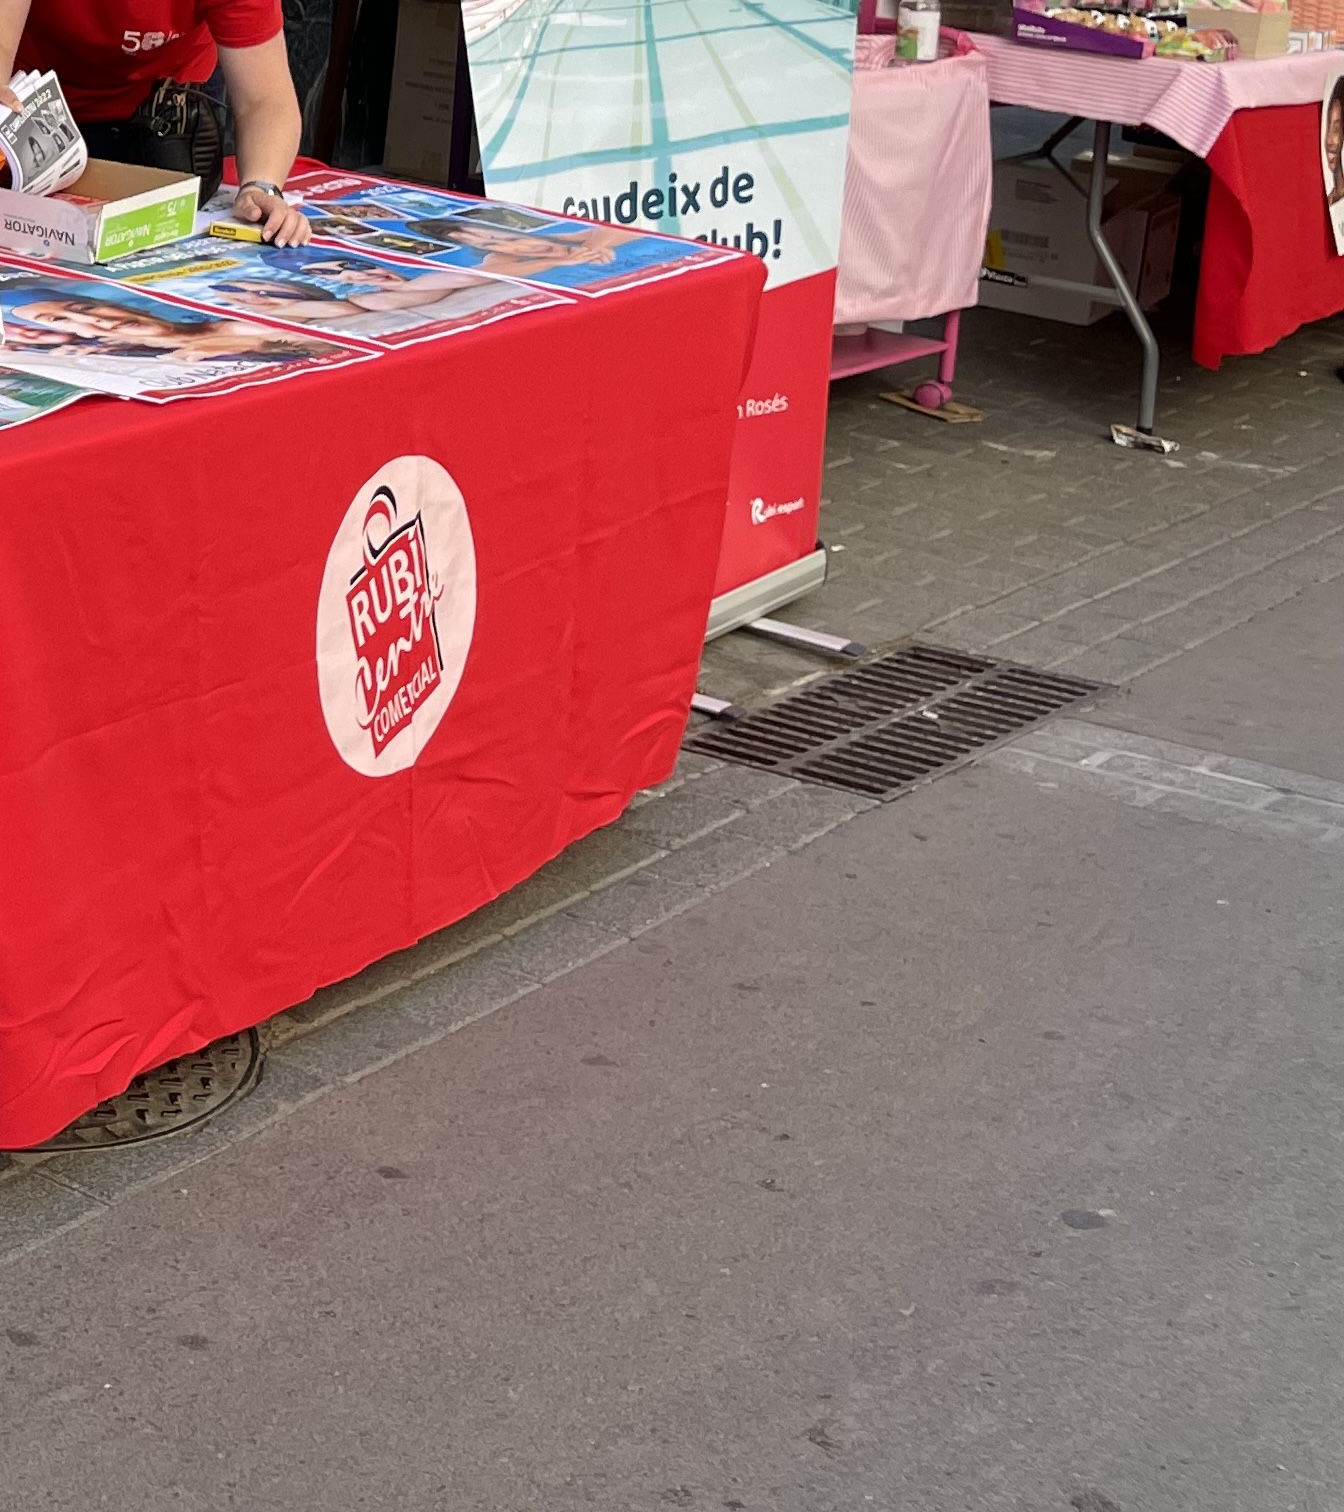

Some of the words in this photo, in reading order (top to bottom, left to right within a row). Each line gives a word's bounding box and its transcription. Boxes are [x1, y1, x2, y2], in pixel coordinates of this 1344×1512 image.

[710, 165, 755, 209] de
[4, 218, 76, 246] NAVIGATOR
[746, 392, 789, 418] Rosés
[350, 532, 424, 648] RUBÍ
